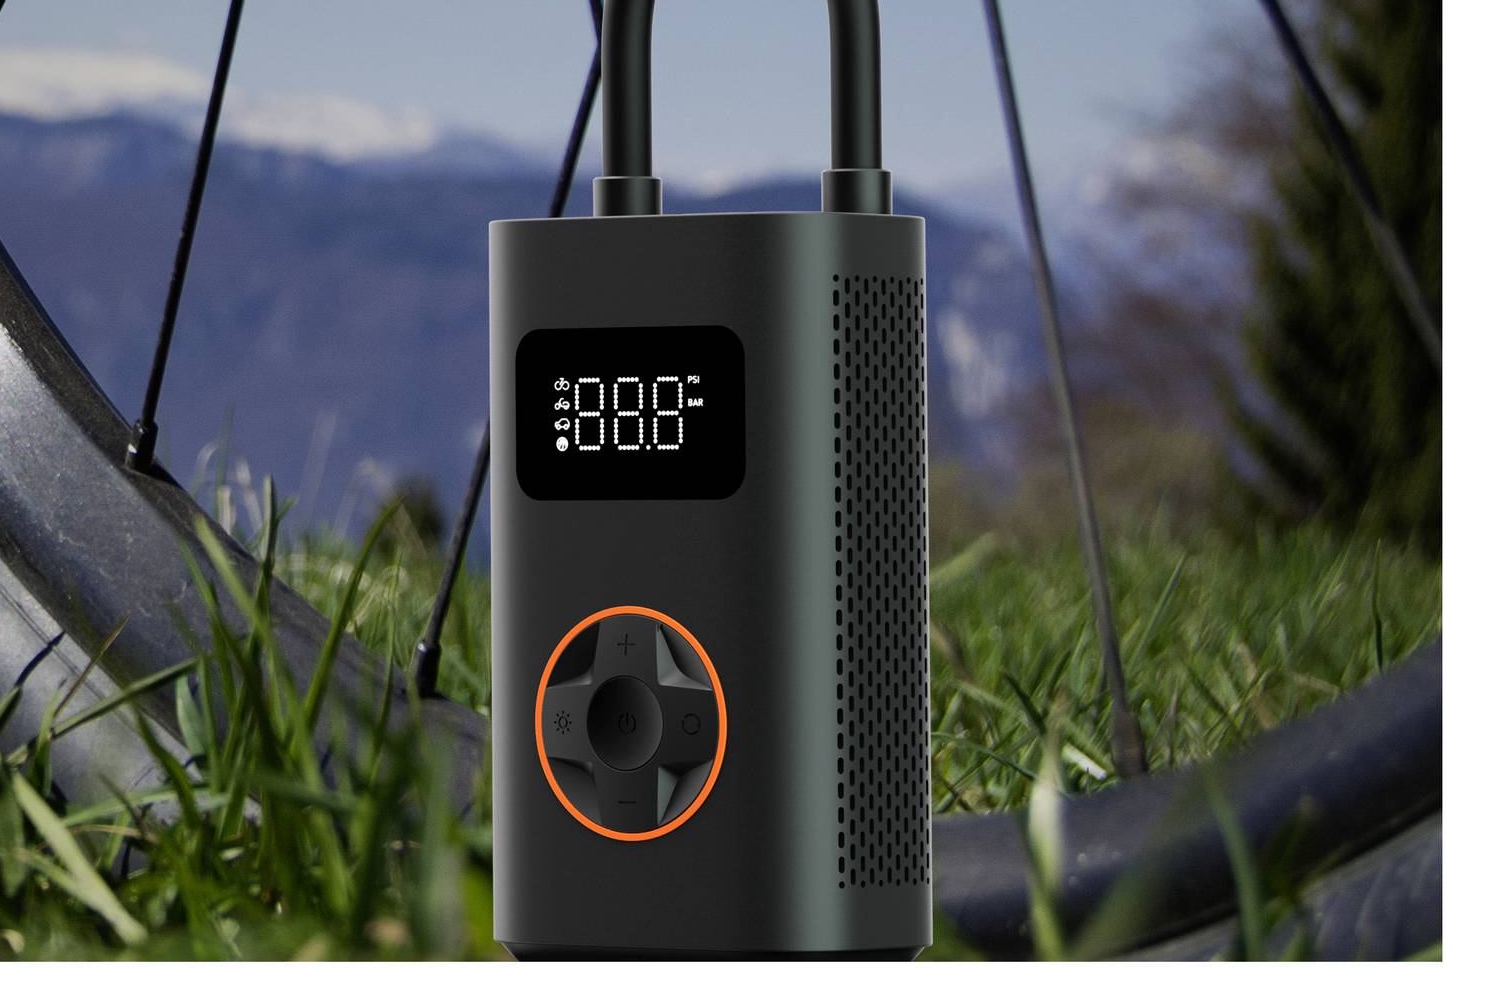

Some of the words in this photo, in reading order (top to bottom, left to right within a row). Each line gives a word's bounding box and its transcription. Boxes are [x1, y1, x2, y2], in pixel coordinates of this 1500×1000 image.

[687, 375, 700, 384] PSI
[687, 397, 704, 407] BAR
[574, 375, 684, 452] 88.8
